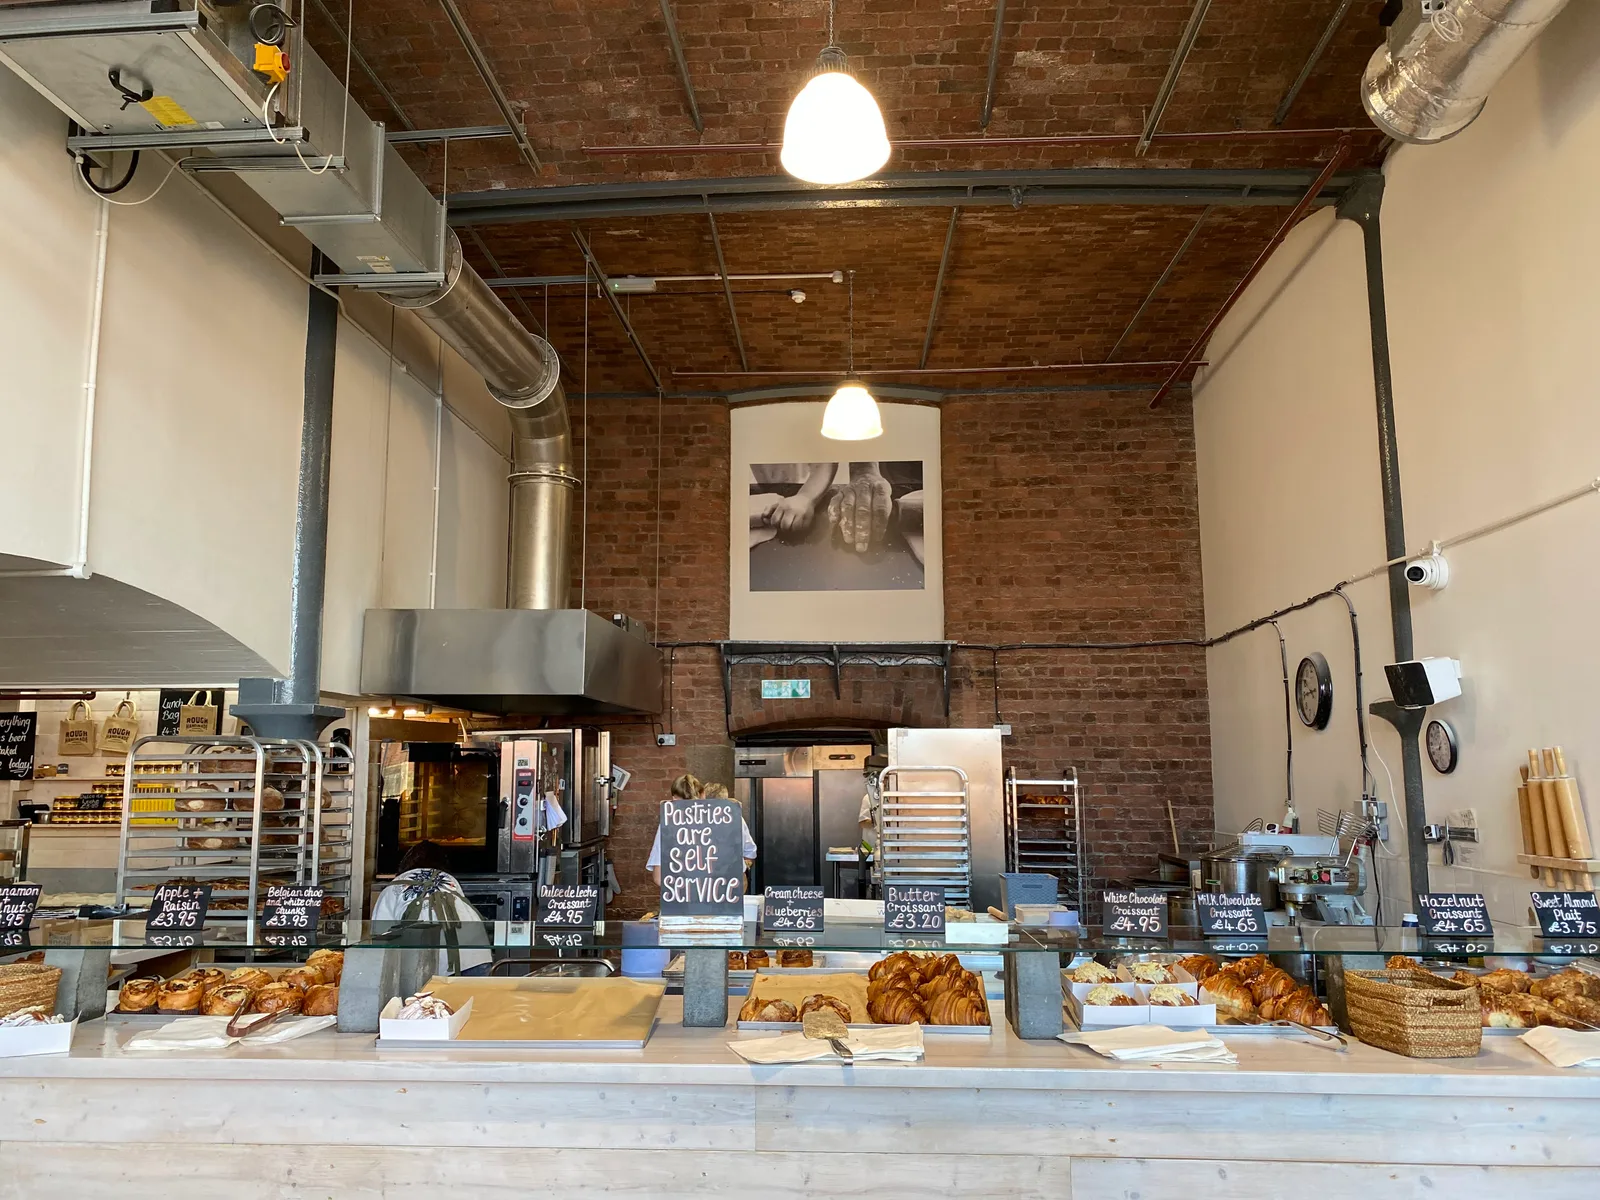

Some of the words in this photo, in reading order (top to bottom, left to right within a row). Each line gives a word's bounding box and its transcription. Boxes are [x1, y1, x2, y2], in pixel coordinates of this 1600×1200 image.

[162, 698, 184, 709] Lunch
[162, 710, 180, 724] Bag
[186, 716, 208, 724] ROUGH
[8, 732, 26, 743] been
[65, 730, 88, 738] ROUGH
[107, 727, 131, 736] ROUGH
[664, 801, 732, 826] Pastries
[676, 827, 712, 846] are
[154, 886, 189, 901] Apple
[193, 887, 204, 899] +
[267, 886, 303, 899] Belgian
[304, 886, 324, 897] choc
[541, 885, 564, 898] Dulce
[564, 885, 575, 898] de
[764, 886, 792, 899] Cream
[888, 887, 940, 902] Butter
[266, 898, 282, 906] and
[283, 897, 305, 906] white
[548, 898, 592, 909] Croissant
[1103, 892, 1127, 904] White
[1129, 892, 1167, 905] Chocolate
[1219, 893, 1262, 906] Chocolate
[1418, 894, 1484, 907] Hazelnut
[1532, 892, 1562, 909] Sweet
[1563, 893, 1599, 908] Almond
[163, 900, 201, 912] Raisin
[765, 905, 823, 917] Blueberries
[887, 902, 945, 913] Croissant
[1112, 905, 1161, 916] Croissant
[151, 911, 198, 927] £3.95
[543, 910, 583, 924] £4.95
[1210, 907, 1253, 919] Croissant
[1429, 907, 1483, 919] Croissant
[1553, 909, 1582, 921] Plait
[266, 915, 309, 927] £3.95
[773, 916, 816, 929] £4.65
[888, 912, 941, 929] £3.20
[1110, 916, 1161, 932] £4.95
[1211, 917, 1258, 932] £4.65
[1432, 919, 1487, 932] £4.65
[1548, 921, 1597, 934] £3.75
